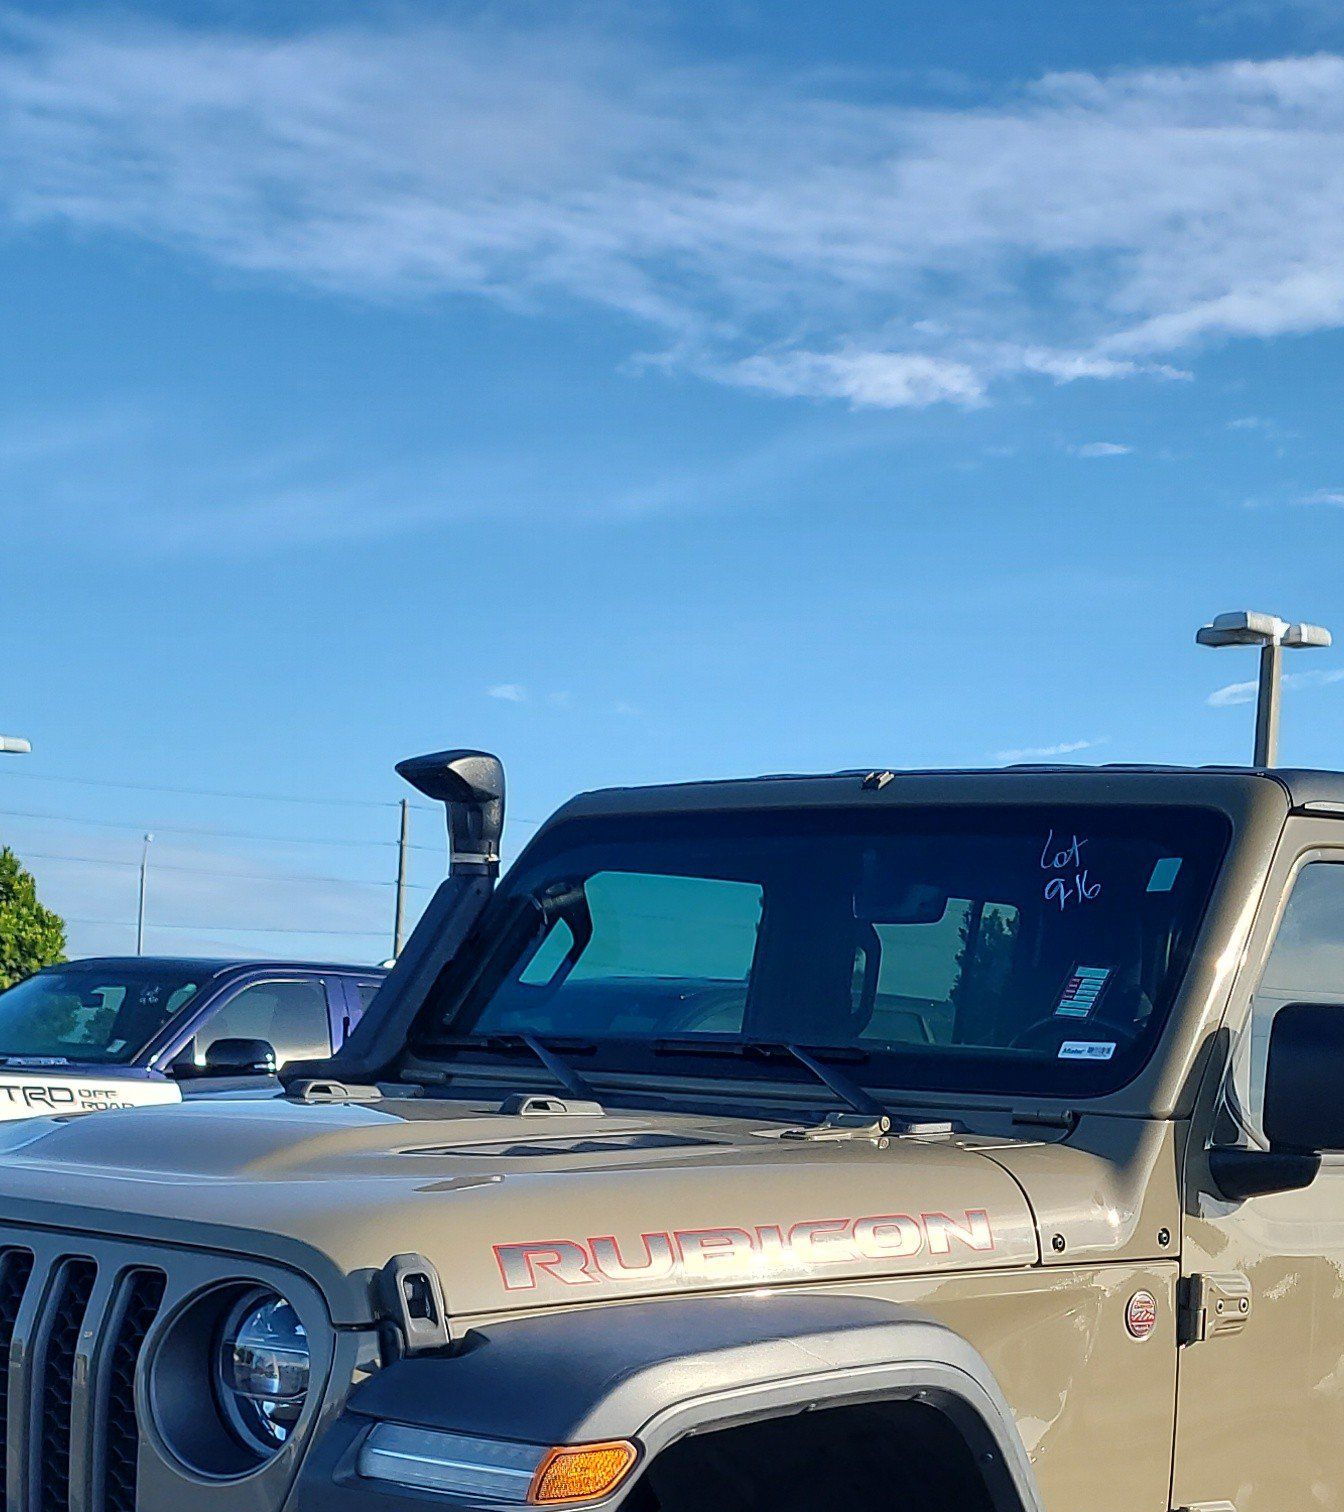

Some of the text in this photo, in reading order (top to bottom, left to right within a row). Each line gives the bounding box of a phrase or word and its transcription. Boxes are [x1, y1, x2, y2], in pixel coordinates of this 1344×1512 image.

[1040, 829, 1089, 869] Lot
[78, 1088, 118, 1099] OFF
[491, 1208, 995, 1292] RUBICON
